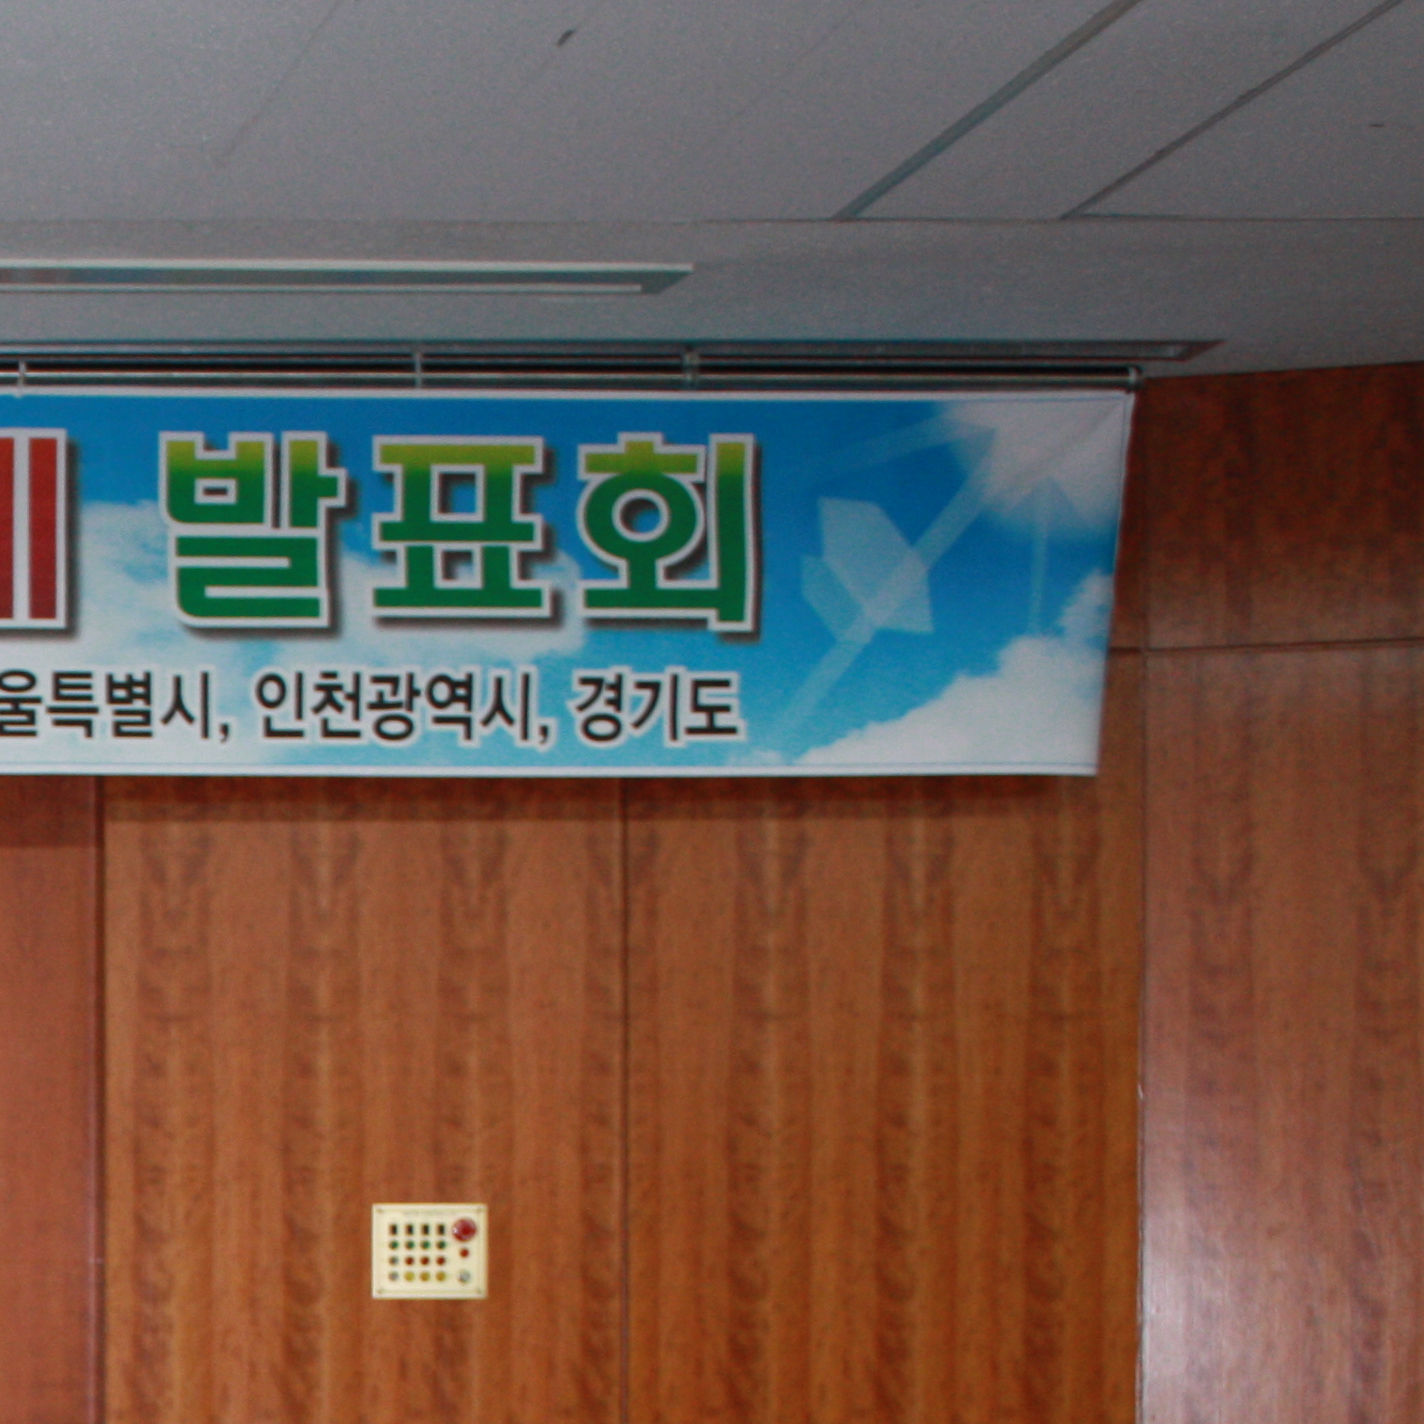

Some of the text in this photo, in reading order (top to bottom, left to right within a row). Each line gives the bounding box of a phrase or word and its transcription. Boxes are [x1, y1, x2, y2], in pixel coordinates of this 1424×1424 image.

[165, 437, 749, 624] 발표회
[254, 669, 554, 745] 인천광역시,
[574, 671, 740, 743] 경기도
